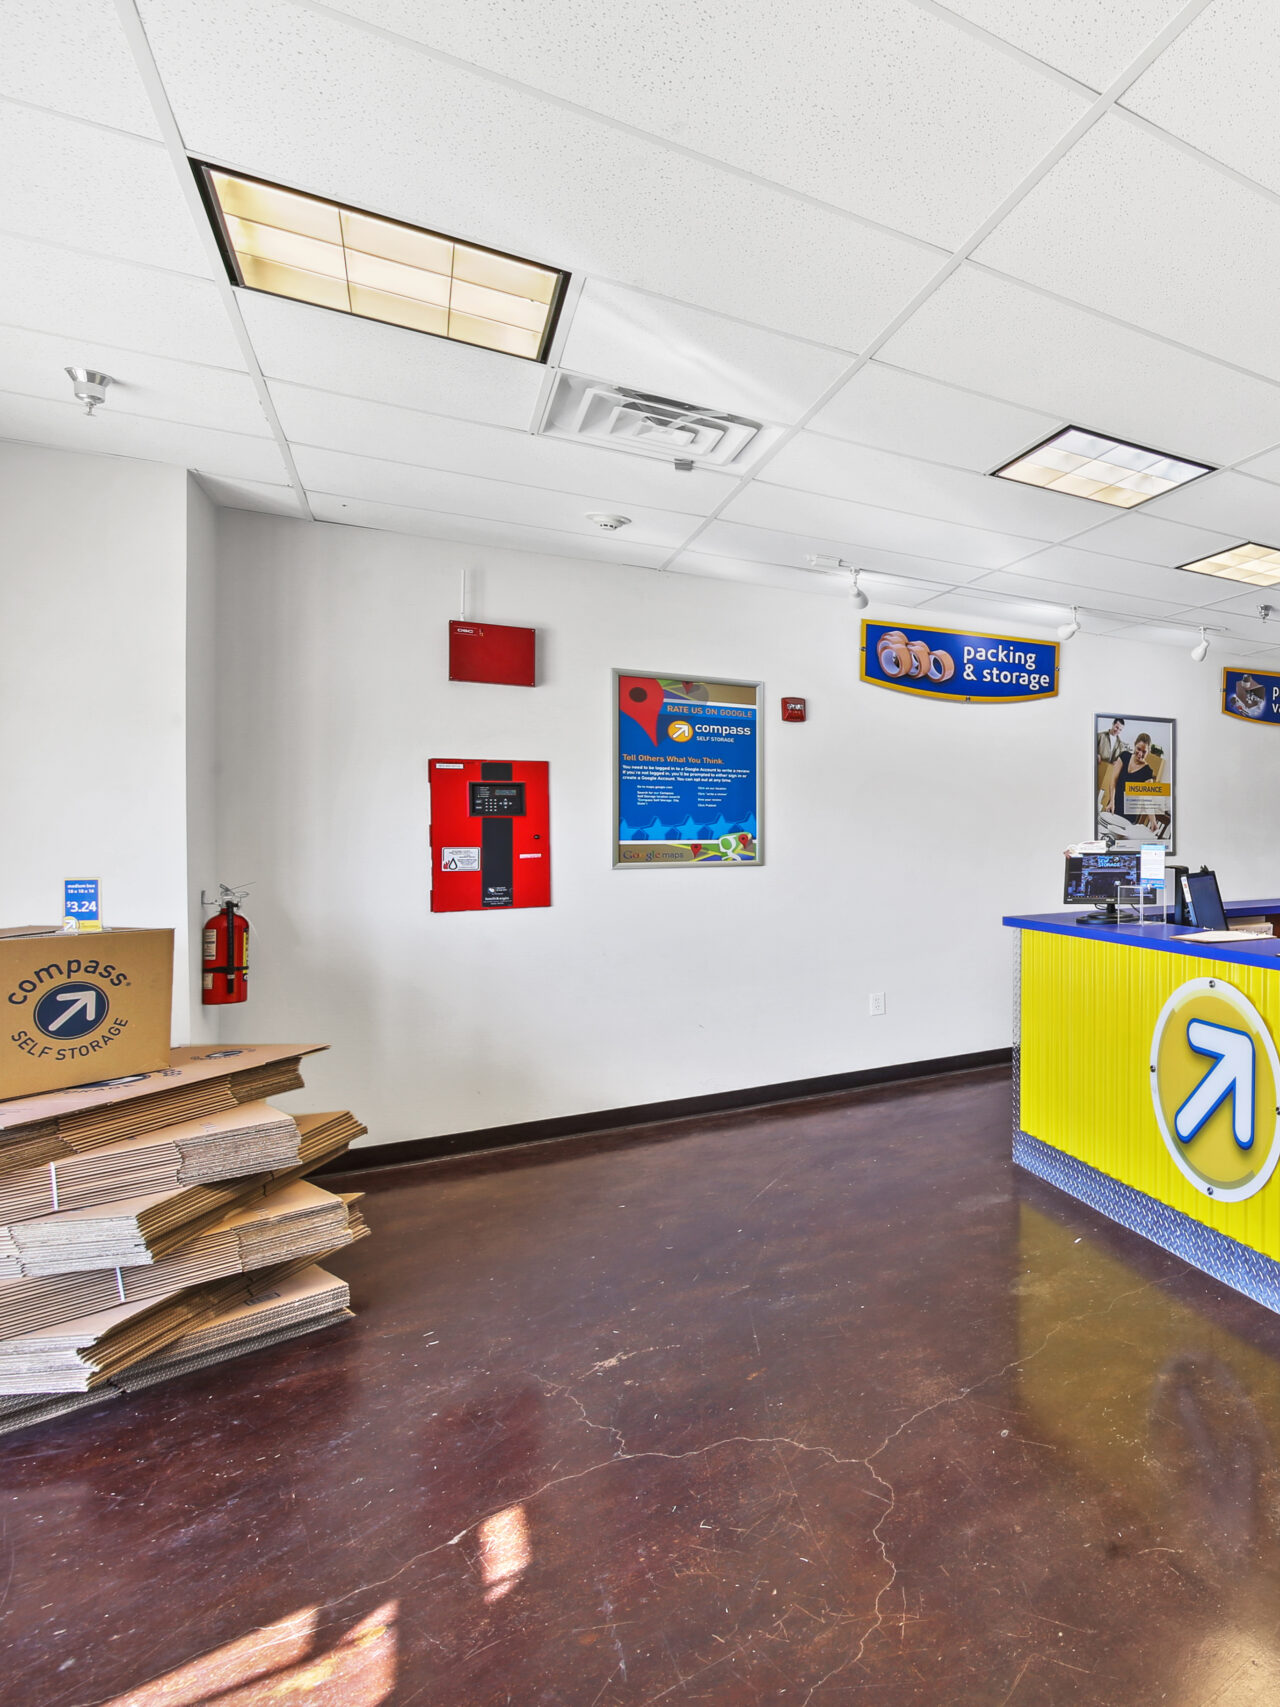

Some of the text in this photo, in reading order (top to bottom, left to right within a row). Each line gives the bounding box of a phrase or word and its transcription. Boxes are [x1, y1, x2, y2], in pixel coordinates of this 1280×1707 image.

[963, 645, 1036, 670] packing
[963, 663, 1050, 691] & storage
[667, 705, 689, 713] RATE
[691, 707, 703, 715] US
[720, 709, 753, 718] GOOGLE
[695, 724, 751, 737] compass
[622, 753, 636, 761] Tell
[638, 754, 664, 762] Others
[1129, 785, 1162, 793] INSURANCE
[623, 850, 660, 860] Google
[66, 901, 97, 912] $3.24
[8, 959, 128, 1005] compass
[11, 1017, 129, 1061] SELF STORAGE
